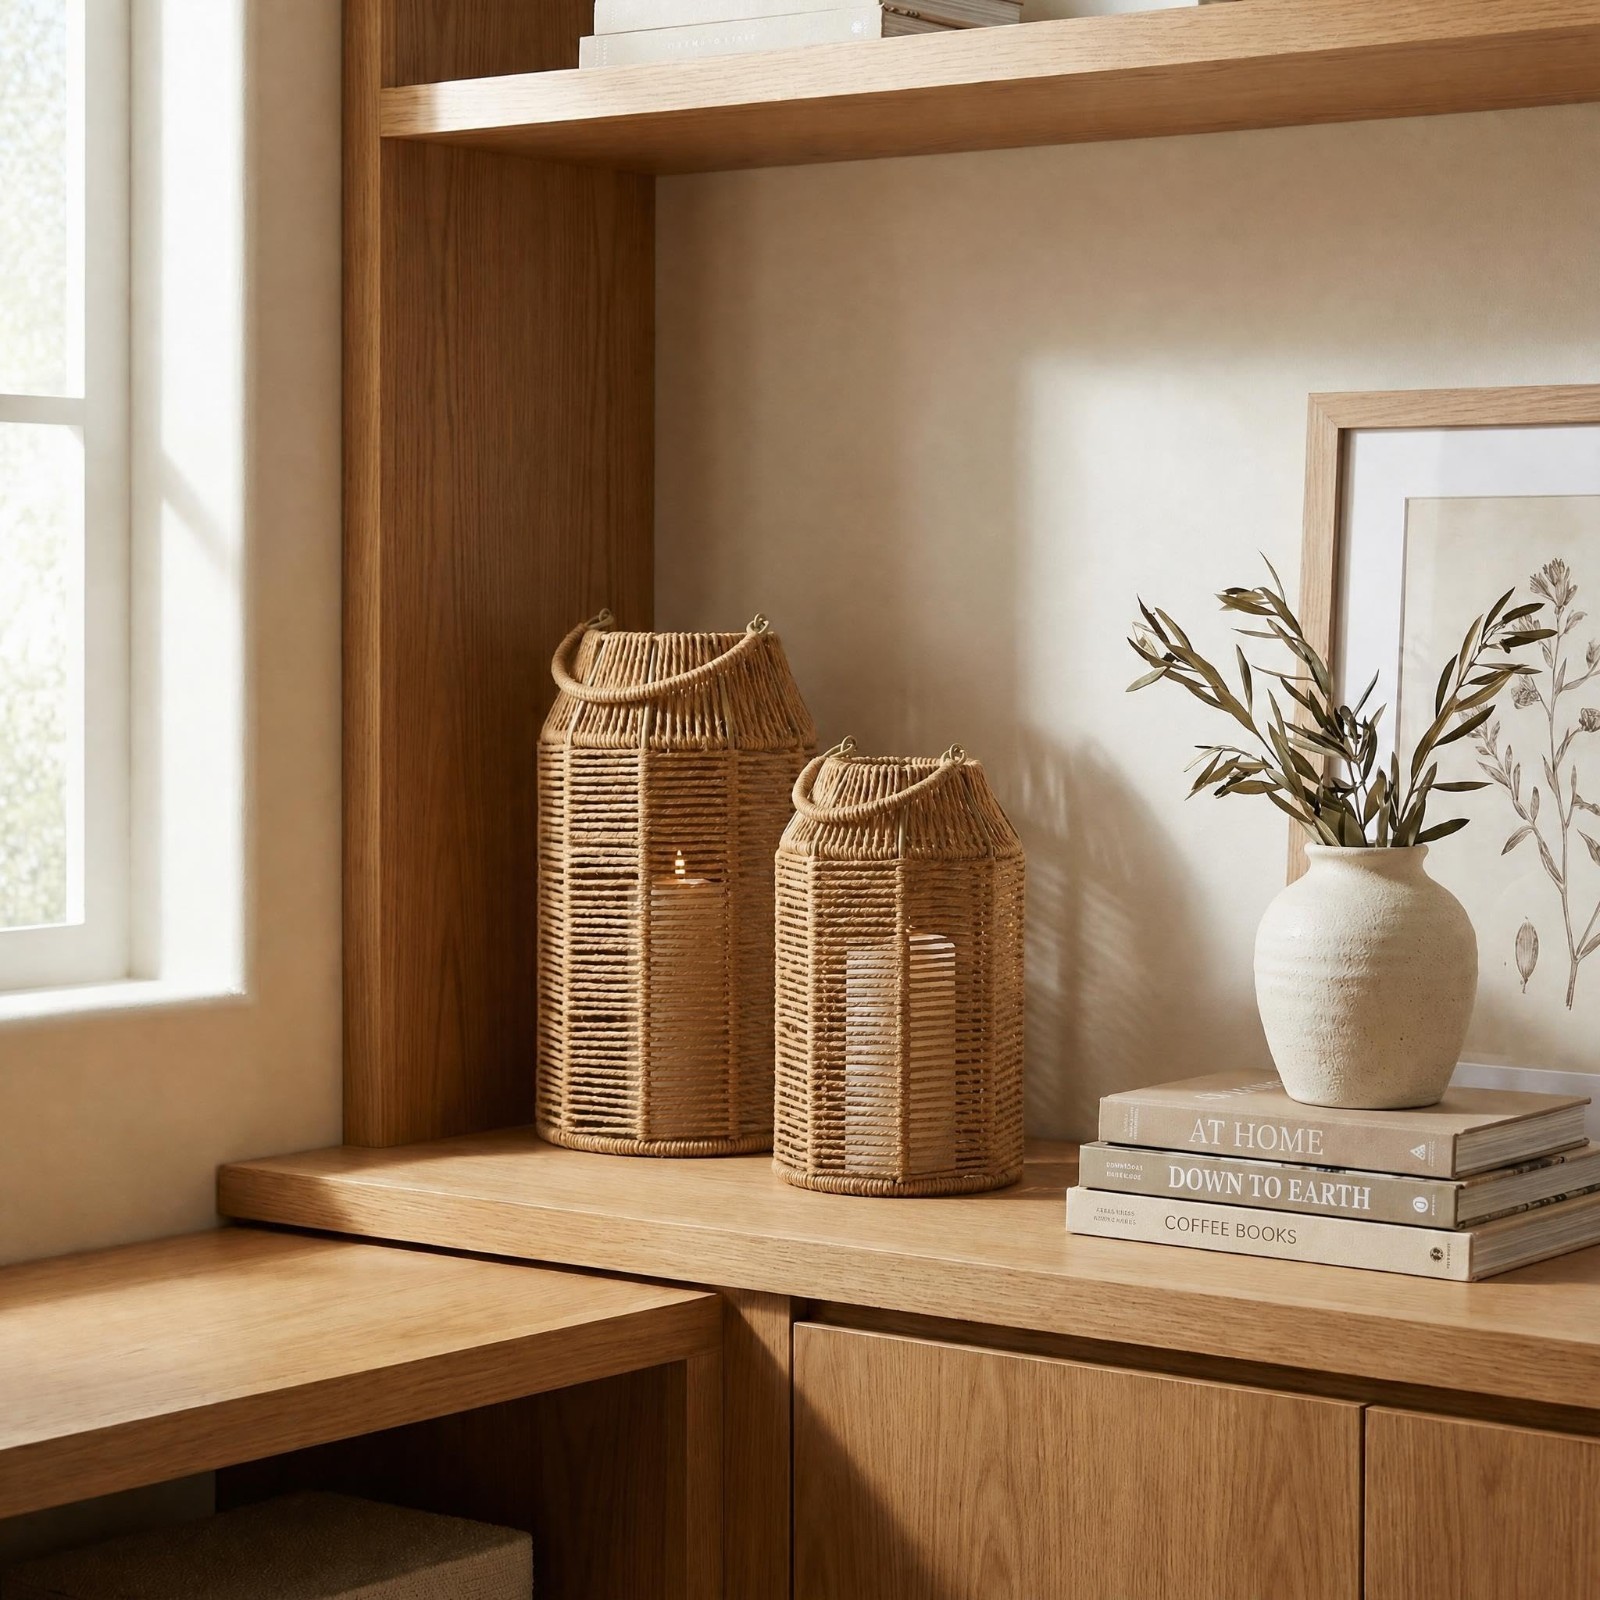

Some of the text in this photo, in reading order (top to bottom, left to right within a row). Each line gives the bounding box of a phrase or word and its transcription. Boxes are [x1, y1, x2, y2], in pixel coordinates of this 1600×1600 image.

[1188, 1118, 1323, 1155] AT HOME
[1168, 1165, 1371, 1210] DOWN TO EARTH
[1165, 1215, 1297, 1245] COFFEE BOOKS
